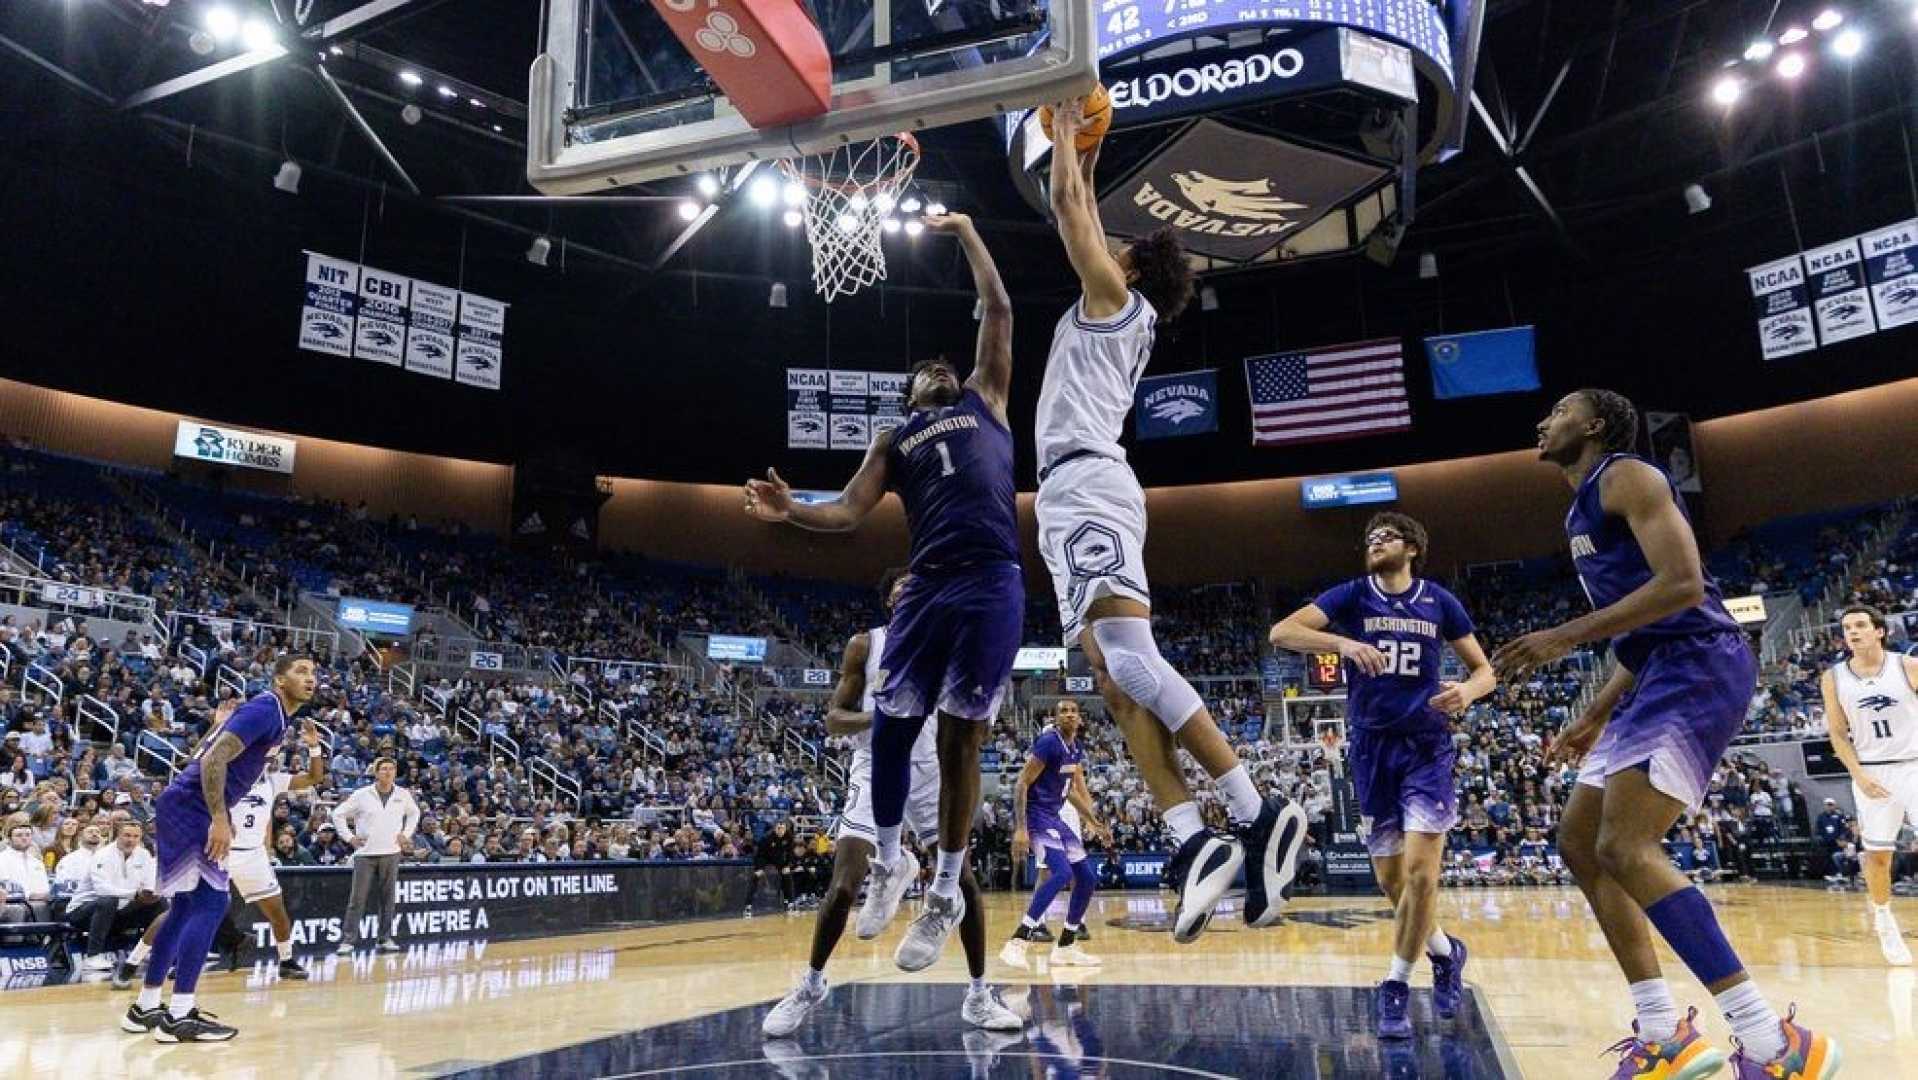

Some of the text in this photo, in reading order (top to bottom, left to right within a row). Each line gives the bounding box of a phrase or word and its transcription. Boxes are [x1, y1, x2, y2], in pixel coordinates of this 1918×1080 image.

[1107, 5, 1140, 34] 42
[1133, 181, 1300, 237] NEVADA
[1873, 231, 1912, 252] NCAA
[1810, 248, 1855, 270] NCAA
[318, 264, 349, 285] NIT
[1754, 267, 1801, 291] NCAA
[365, 277, 401, 300] CBI
[305, 312, 350, 331] NEVADA
[359, 321, 401, 338] NEVADA
[410, 334, 450, 352] NEVADA
[460, 344, 498, 362] NEVADA
[789, 373, 826, 386] NCAA
[1143, 384, 1209, 409] NEVADA
[898, 415, 979, 457] WASHINGTON
[226, 437, 283, 457] RYDER
[225, 449, 281, 467] HOMES
[935, 441, 956, 478] 1
[56, 587, 79, 601] 24
[1363, 616, 1438, 639] WASHINGTON
[475, 653, 498, 668] 26
[1377, 639, 1422, 677] 32
[1071, 678, 1089, 689] 30
[1320, 665, 1336, 682] 12
[1872, 719, 1894, 739] 11
[243, 814, 256, 828] 3
[468, 878, 483, 900] A
[487, 876, 520, 899] LOT
[523, 875, 548, 897] ON
[550, 874, 581, 896] THE
[583, 873, 619, 894] LINE.
[406, 908, 472, 935] WE'RE
[474, 906, 489, 929] A
[11, 956, 48, 971] NSB
